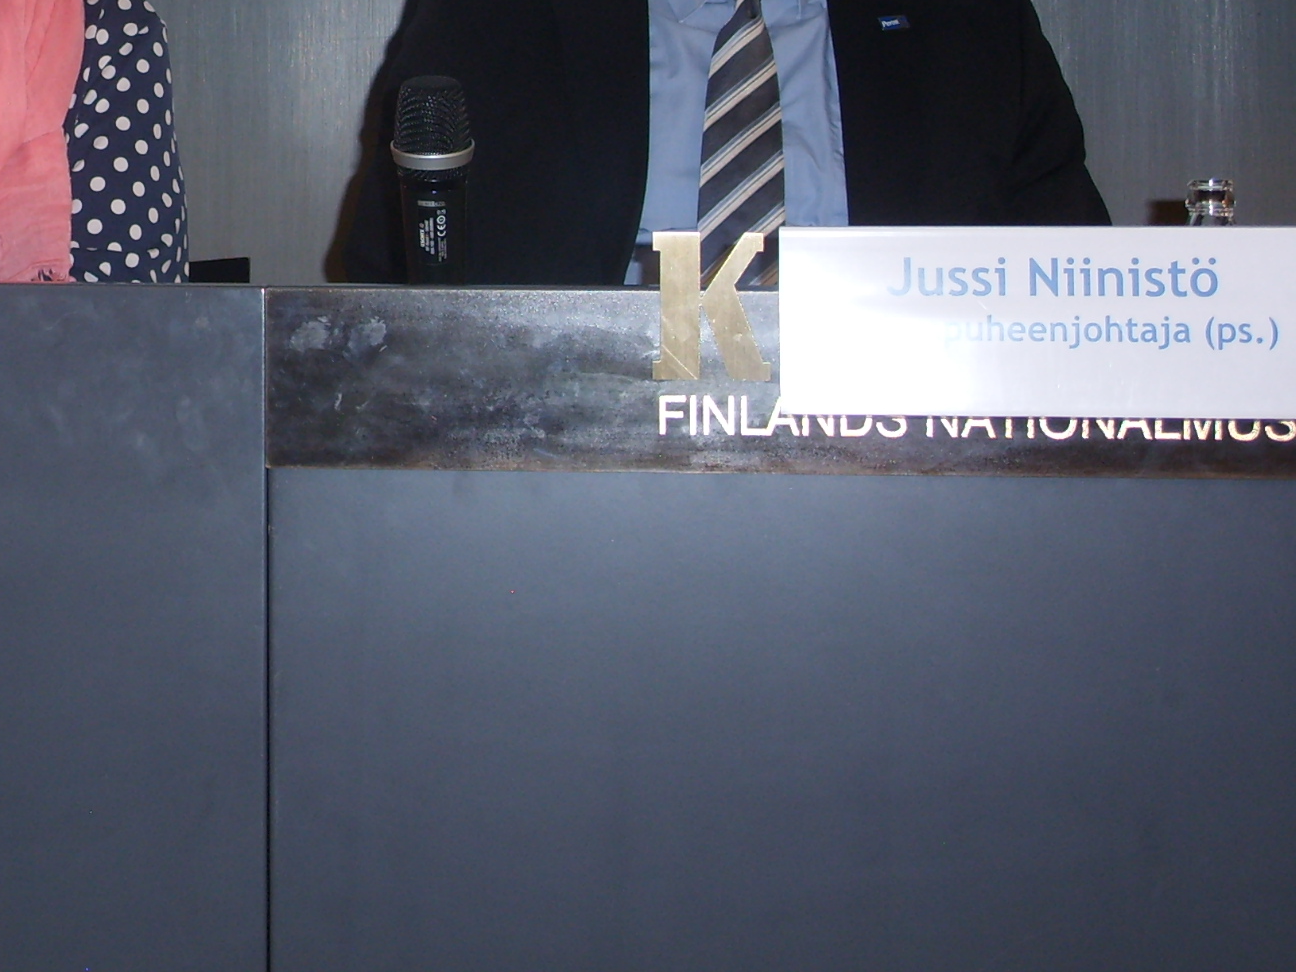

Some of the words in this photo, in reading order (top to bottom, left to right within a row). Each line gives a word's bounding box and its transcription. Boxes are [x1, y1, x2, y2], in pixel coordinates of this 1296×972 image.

[887, 257, 1007, 297] Jussi
[1029, 257, 1219, 298] Niinistö
[1205, 315, 1280, 350] (ps.)
